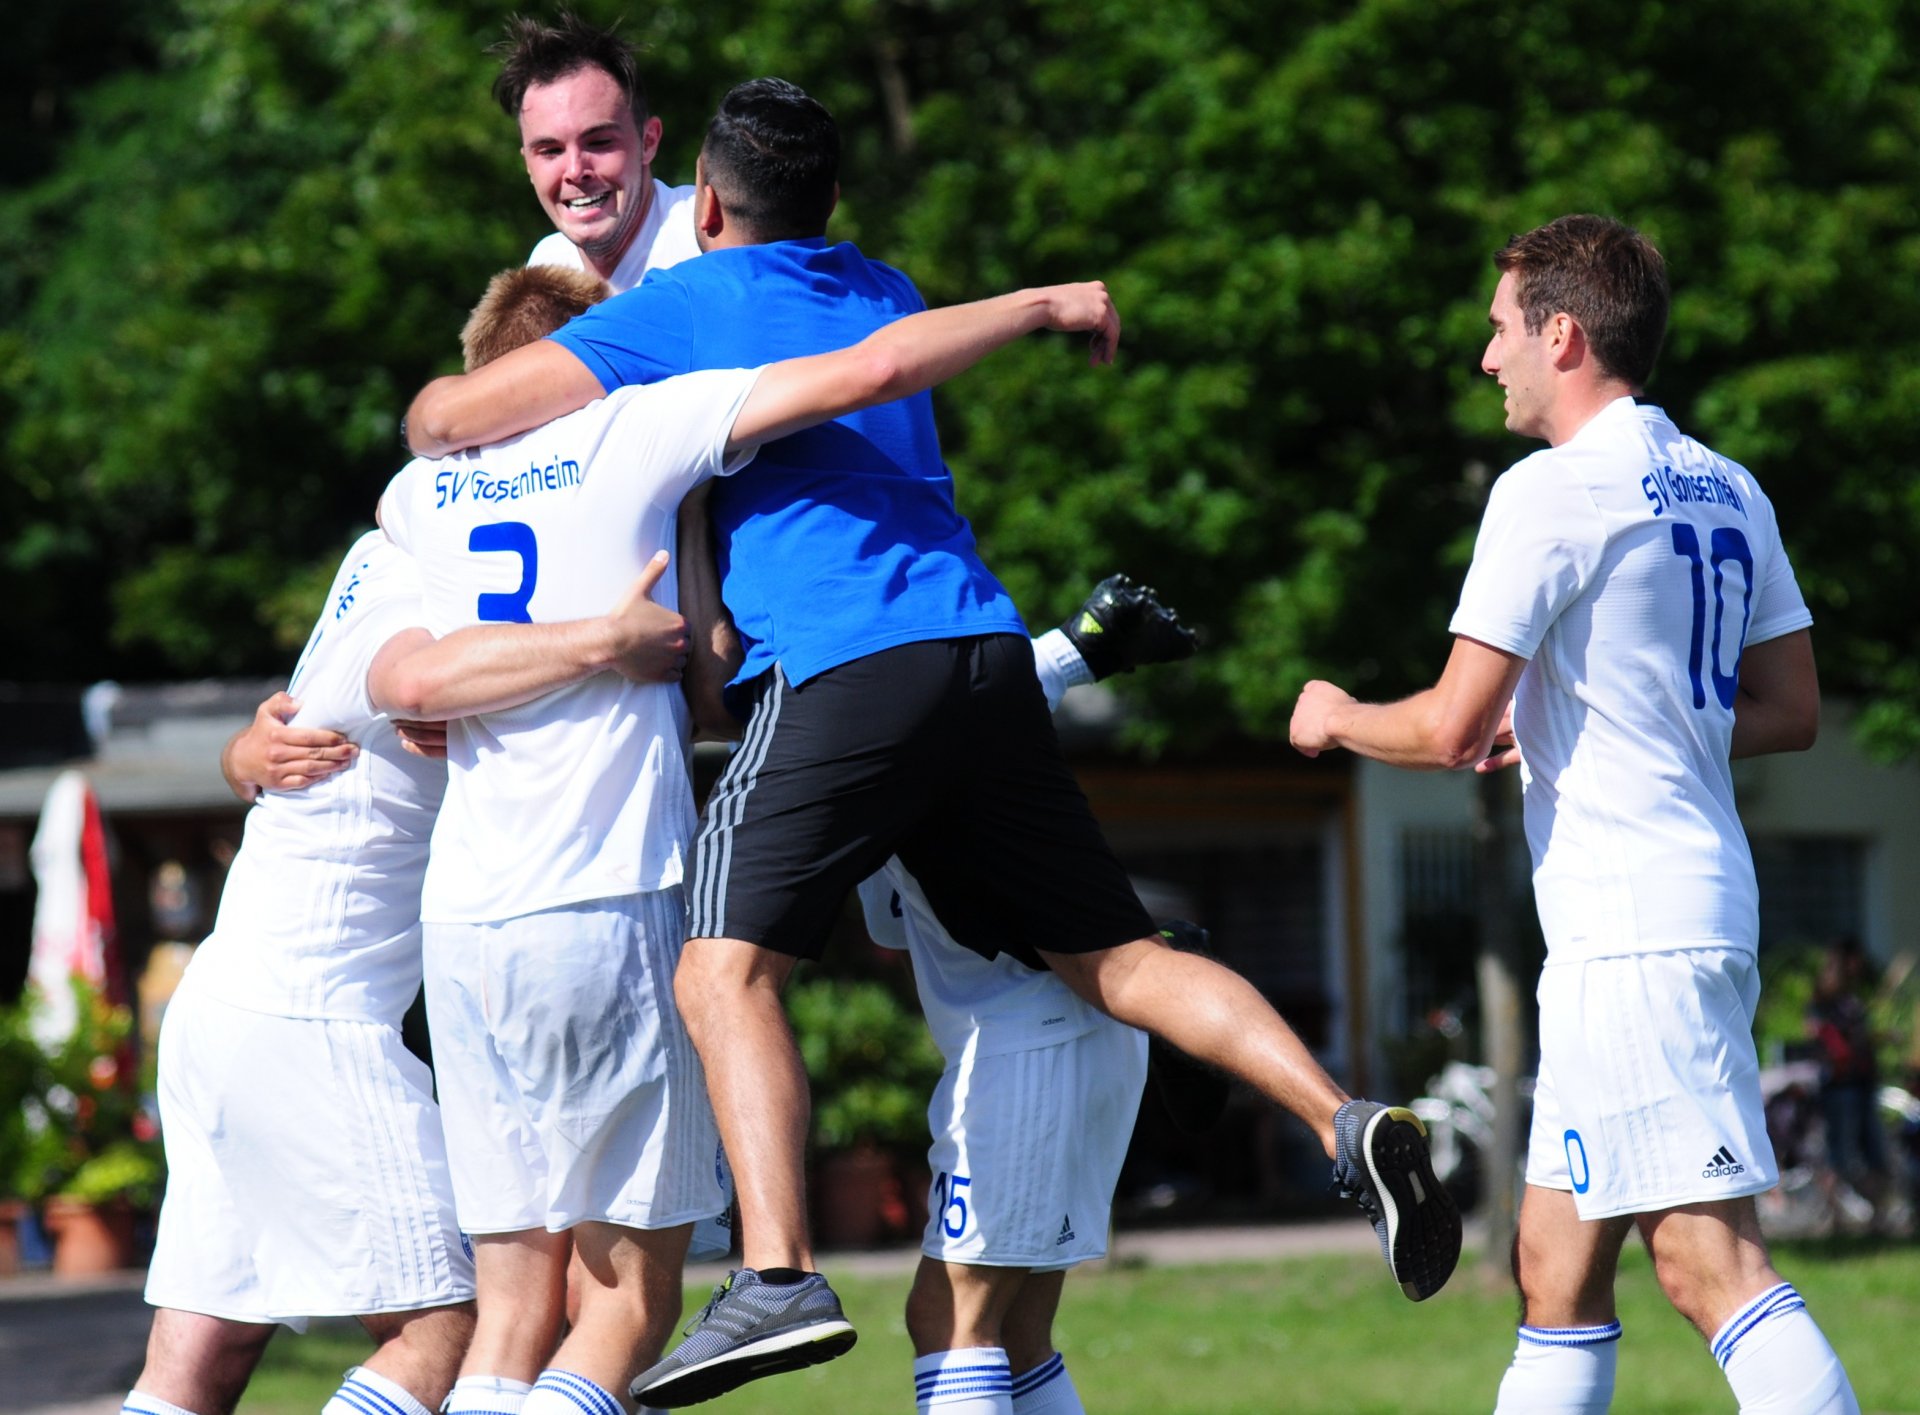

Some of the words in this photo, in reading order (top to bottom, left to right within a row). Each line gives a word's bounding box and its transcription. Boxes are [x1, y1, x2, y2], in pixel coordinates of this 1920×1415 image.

[435, 471, 469, 509] SV
[1641, 467, 1670, 517] SV
[468, 521, 538, 624] 3
[1671, 522, 1753, 710] 10
[1702, 1164, 1745, 1179] adidas
[934, 1171, 971, 1238] 15
